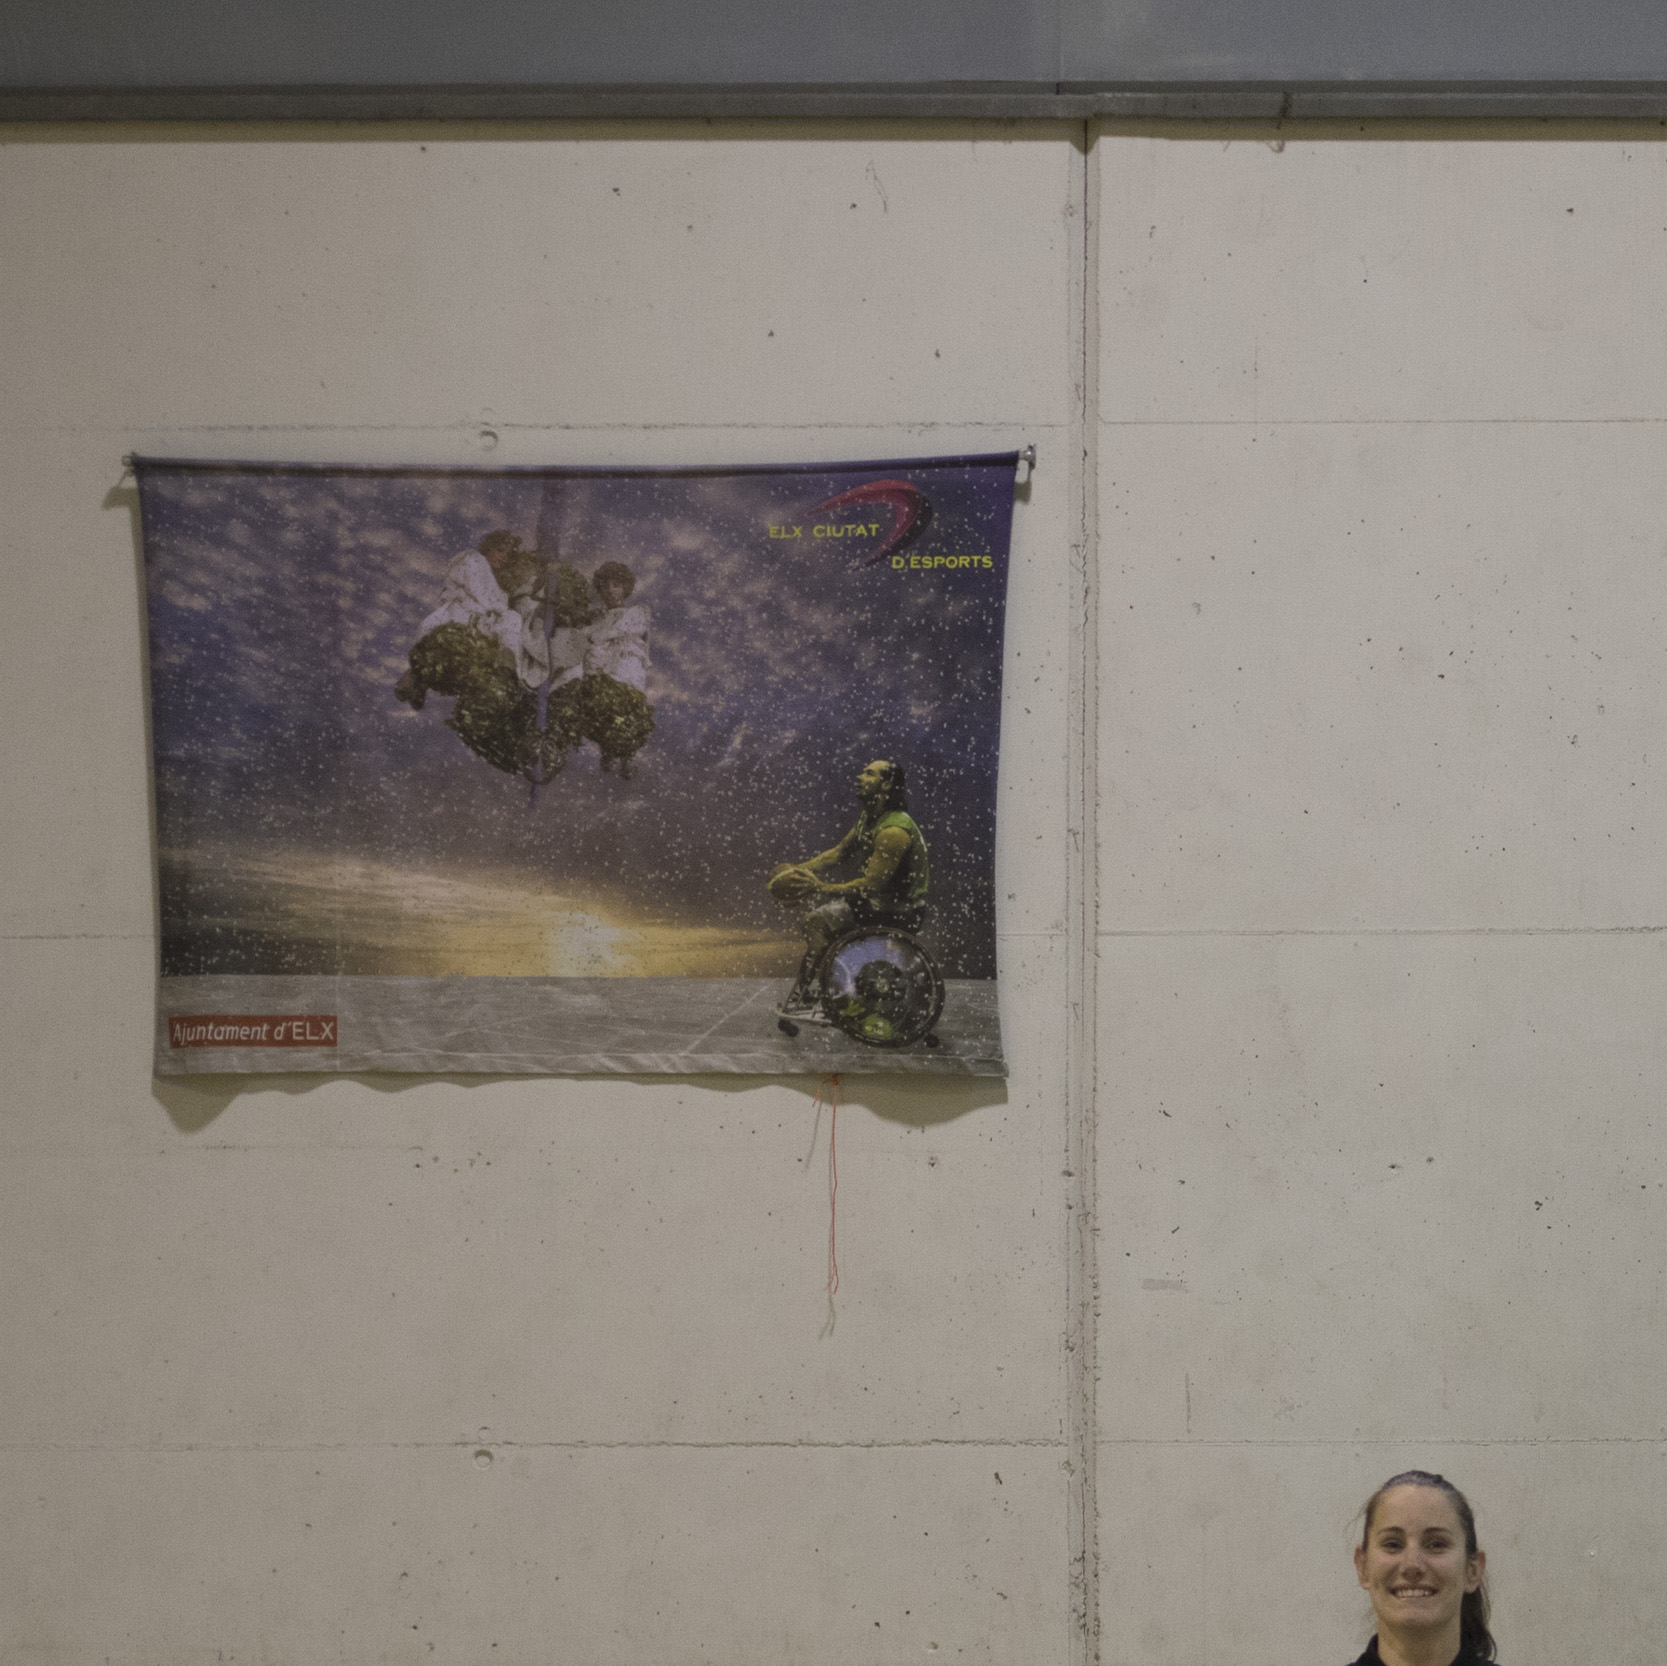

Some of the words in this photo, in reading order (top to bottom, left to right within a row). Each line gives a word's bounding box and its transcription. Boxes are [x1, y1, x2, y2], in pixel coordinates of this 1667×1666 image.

[769, 526, 801, 539] ELX
[812, 524, 880, 538] CIUTAT
[173, 1022, 270, 1046] Ajuntament
[273, 1021, 334, 1040] d'ELX
